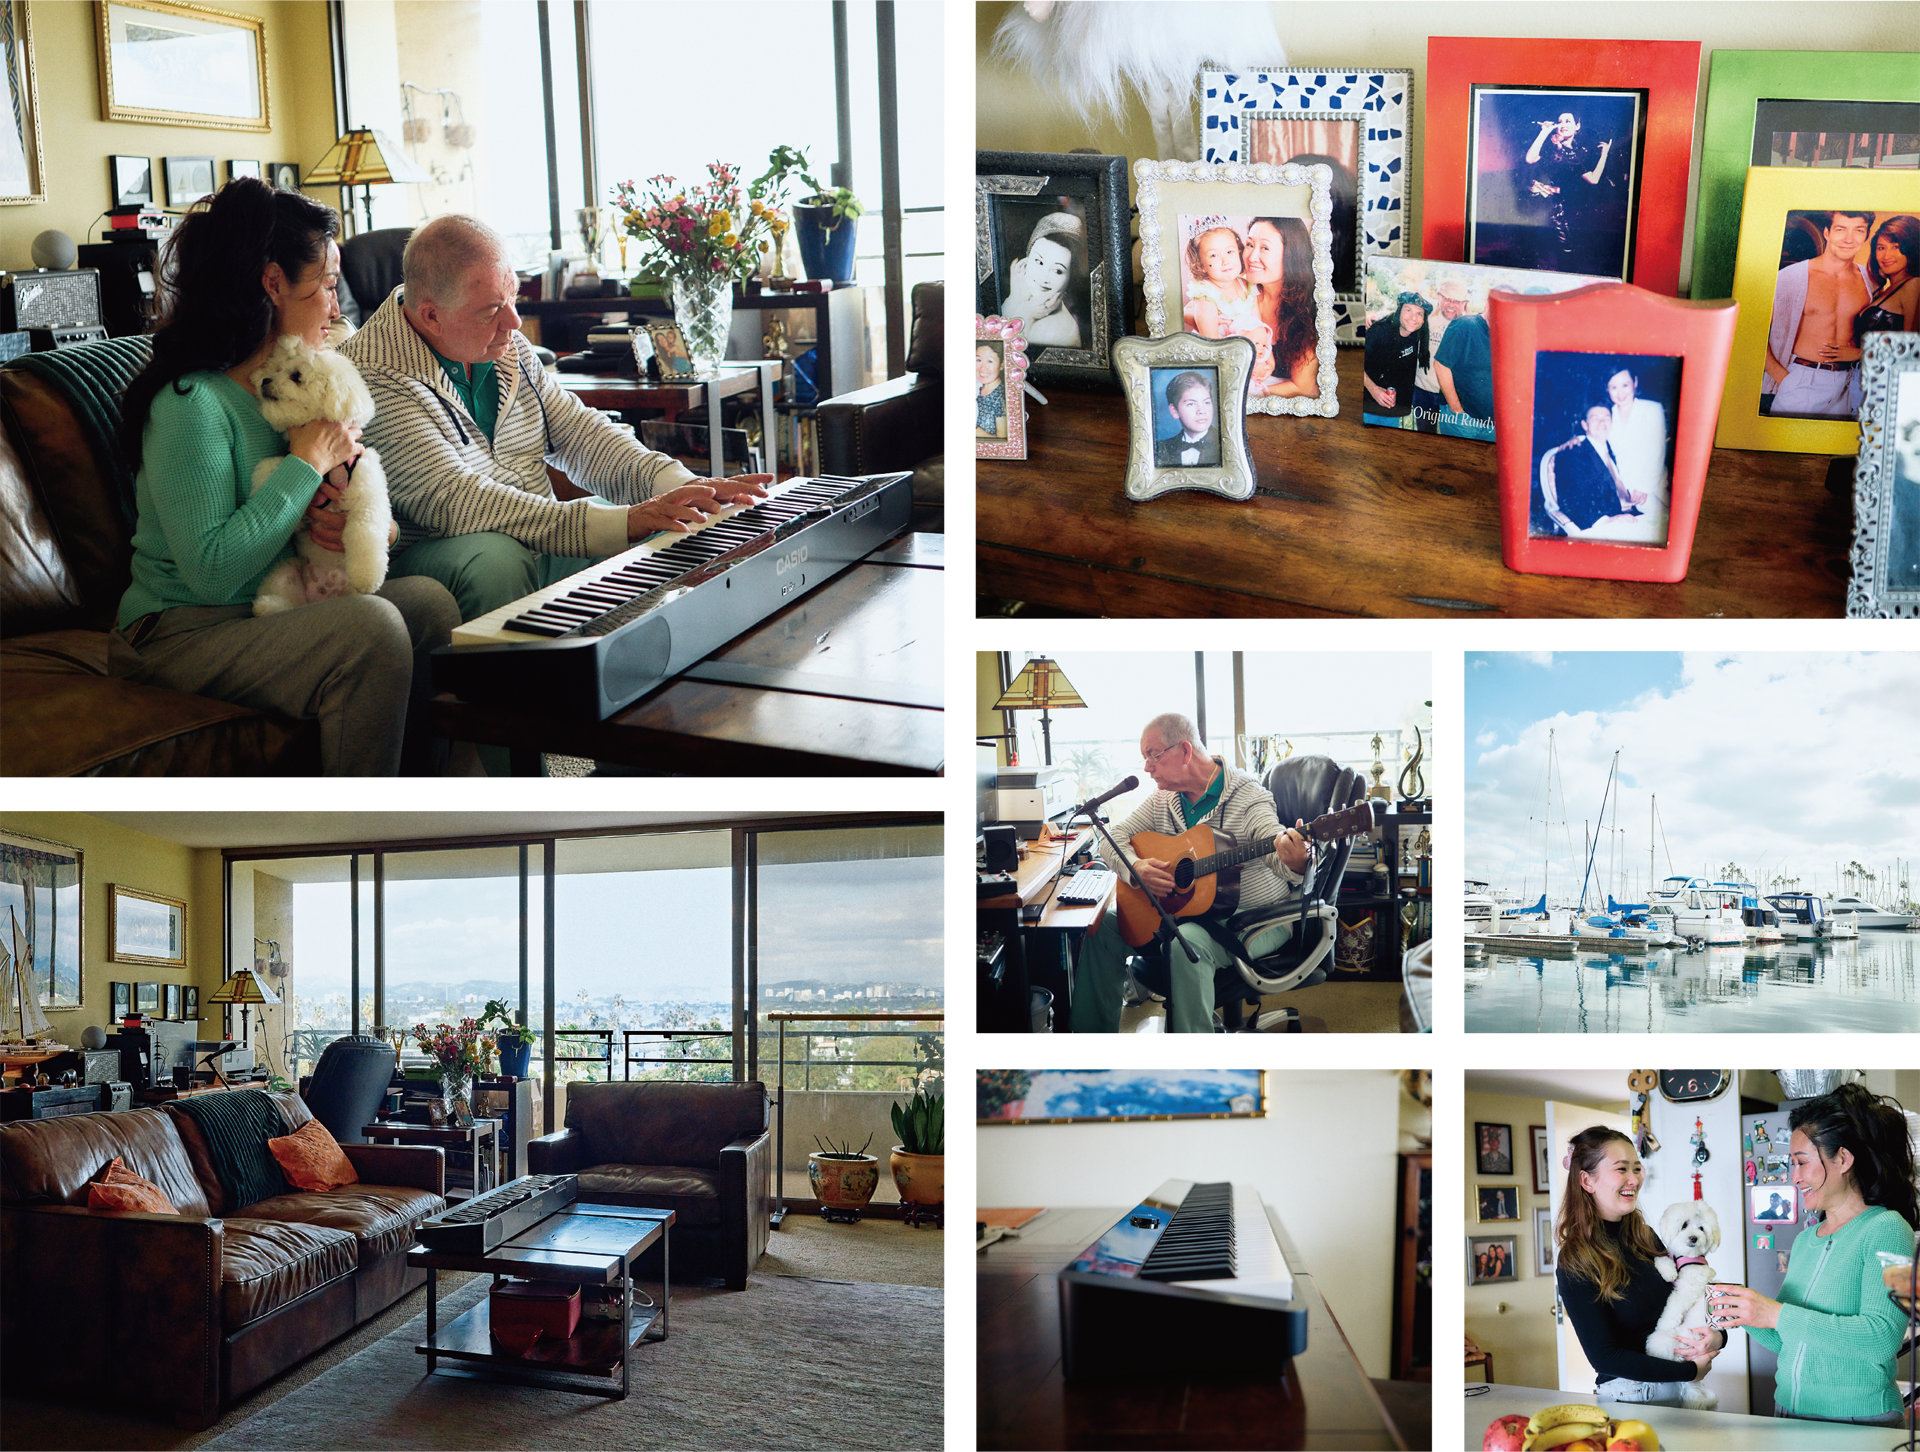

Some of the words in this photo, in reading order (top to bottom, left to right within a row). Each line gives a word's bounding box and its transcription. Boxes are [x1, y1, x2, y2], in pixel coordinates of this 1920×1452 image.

[1413, 405, 1458, 425] Original
[776, 545, 808, 576] CASIO
[1687, 1078, 1699, 1093] 6
